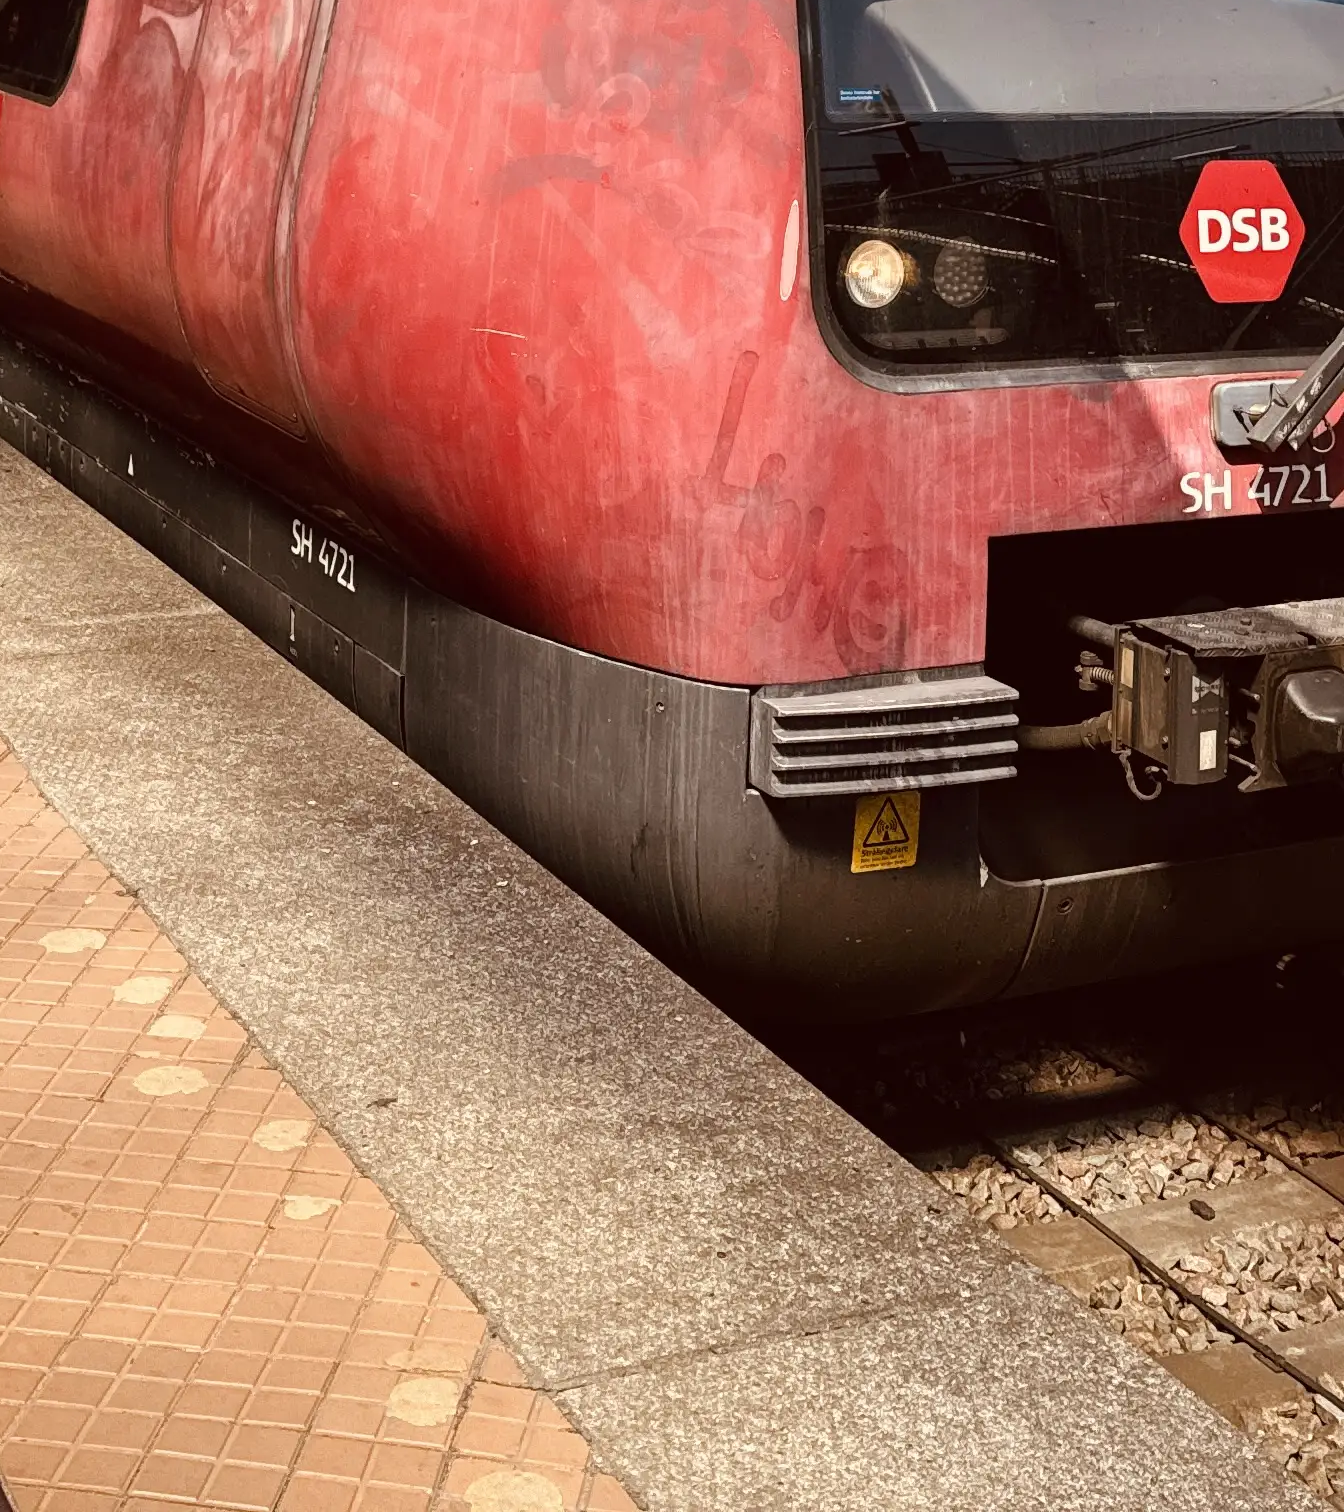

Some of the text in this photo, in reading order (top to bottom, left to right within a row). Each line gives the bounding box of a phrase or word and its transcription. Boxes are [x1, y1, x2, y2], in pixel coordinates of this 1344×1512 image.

[1197, 207, 1290, 253] DSB
[1179, 463, 1334, 514] SH 4721
[291, 518, 356, 593] SH 4721
